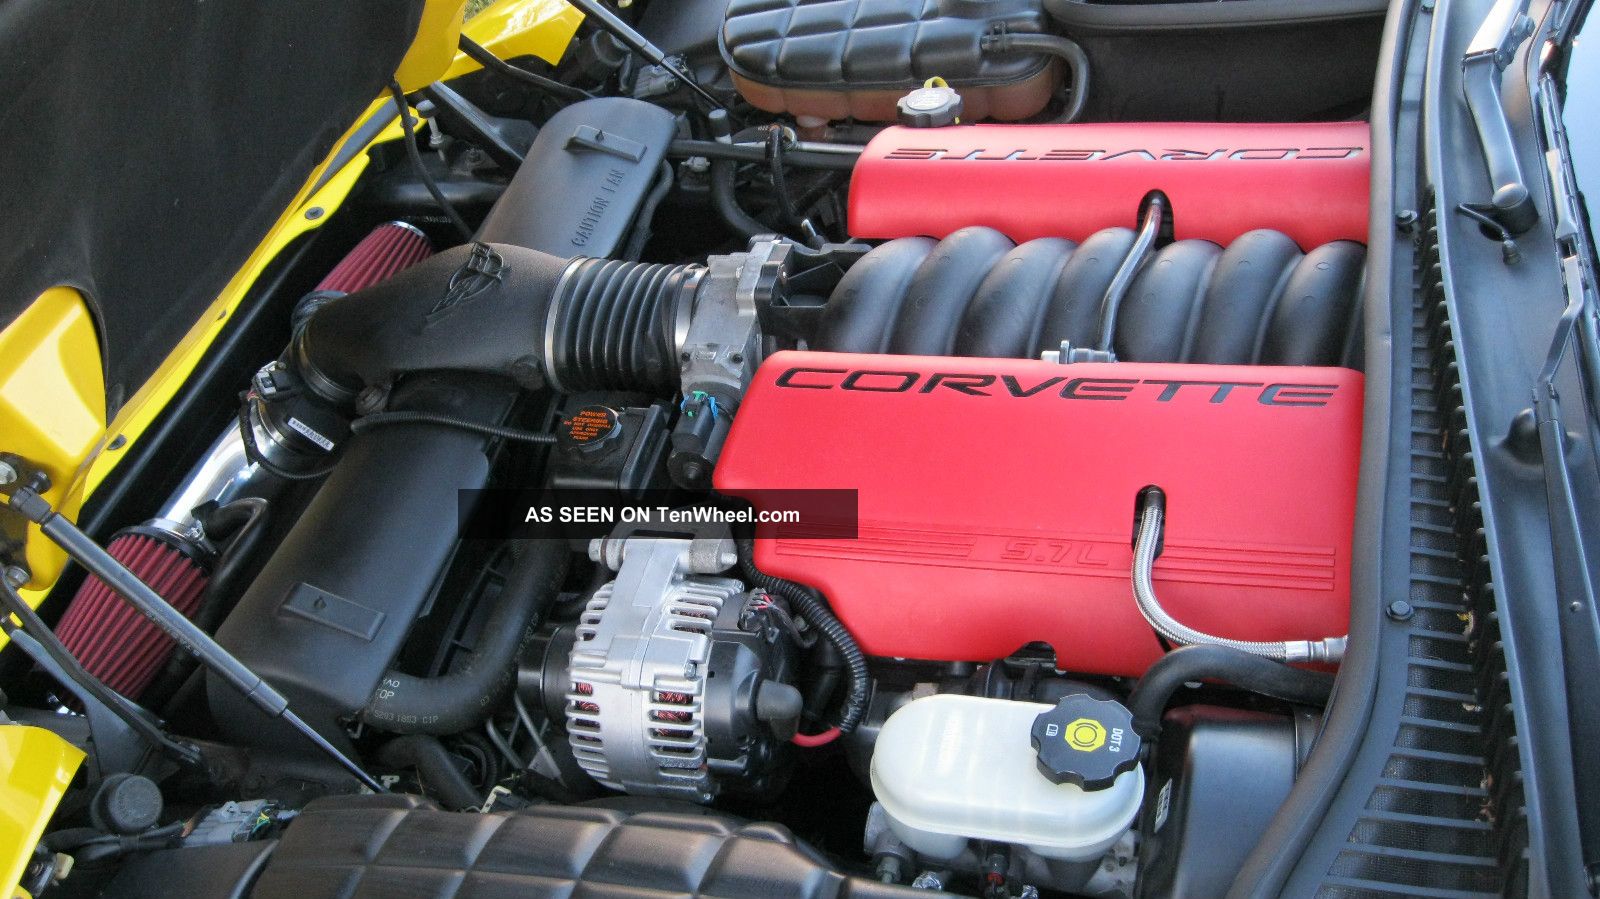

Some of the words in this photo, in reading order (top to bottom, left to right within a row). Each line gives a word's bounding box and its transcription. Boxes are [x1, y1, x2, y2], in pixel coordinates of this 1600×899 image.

[884, 147, 1364, 161] CORVETTE
[571, 197, 609, 247] CAUTION
[775, 367, 1340, 407] CORVETTE
[1000, 538, 1109, 567] 5.7L
